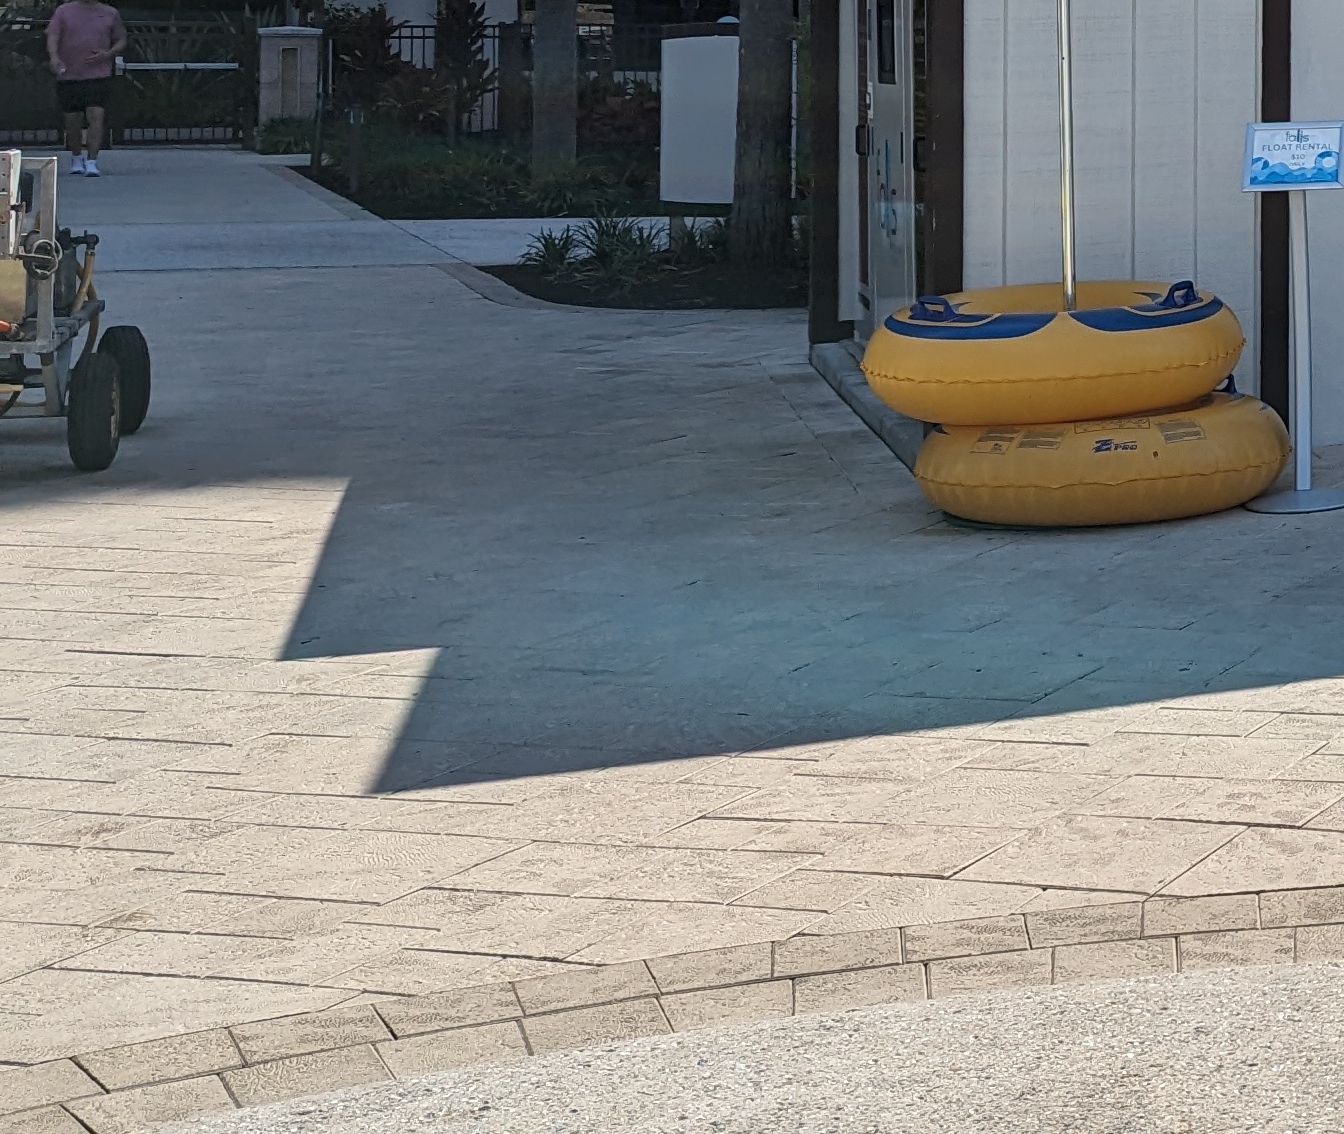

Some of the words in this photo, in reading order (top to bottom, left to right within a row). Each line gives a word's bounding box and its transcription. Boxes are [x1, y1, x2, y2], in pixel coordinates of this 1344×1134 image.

[1286, 129, 1310, 143] falls
[1262, 144, 1293, 152] FLOAT
[1295, 143, 1334, 151] RENTAL
